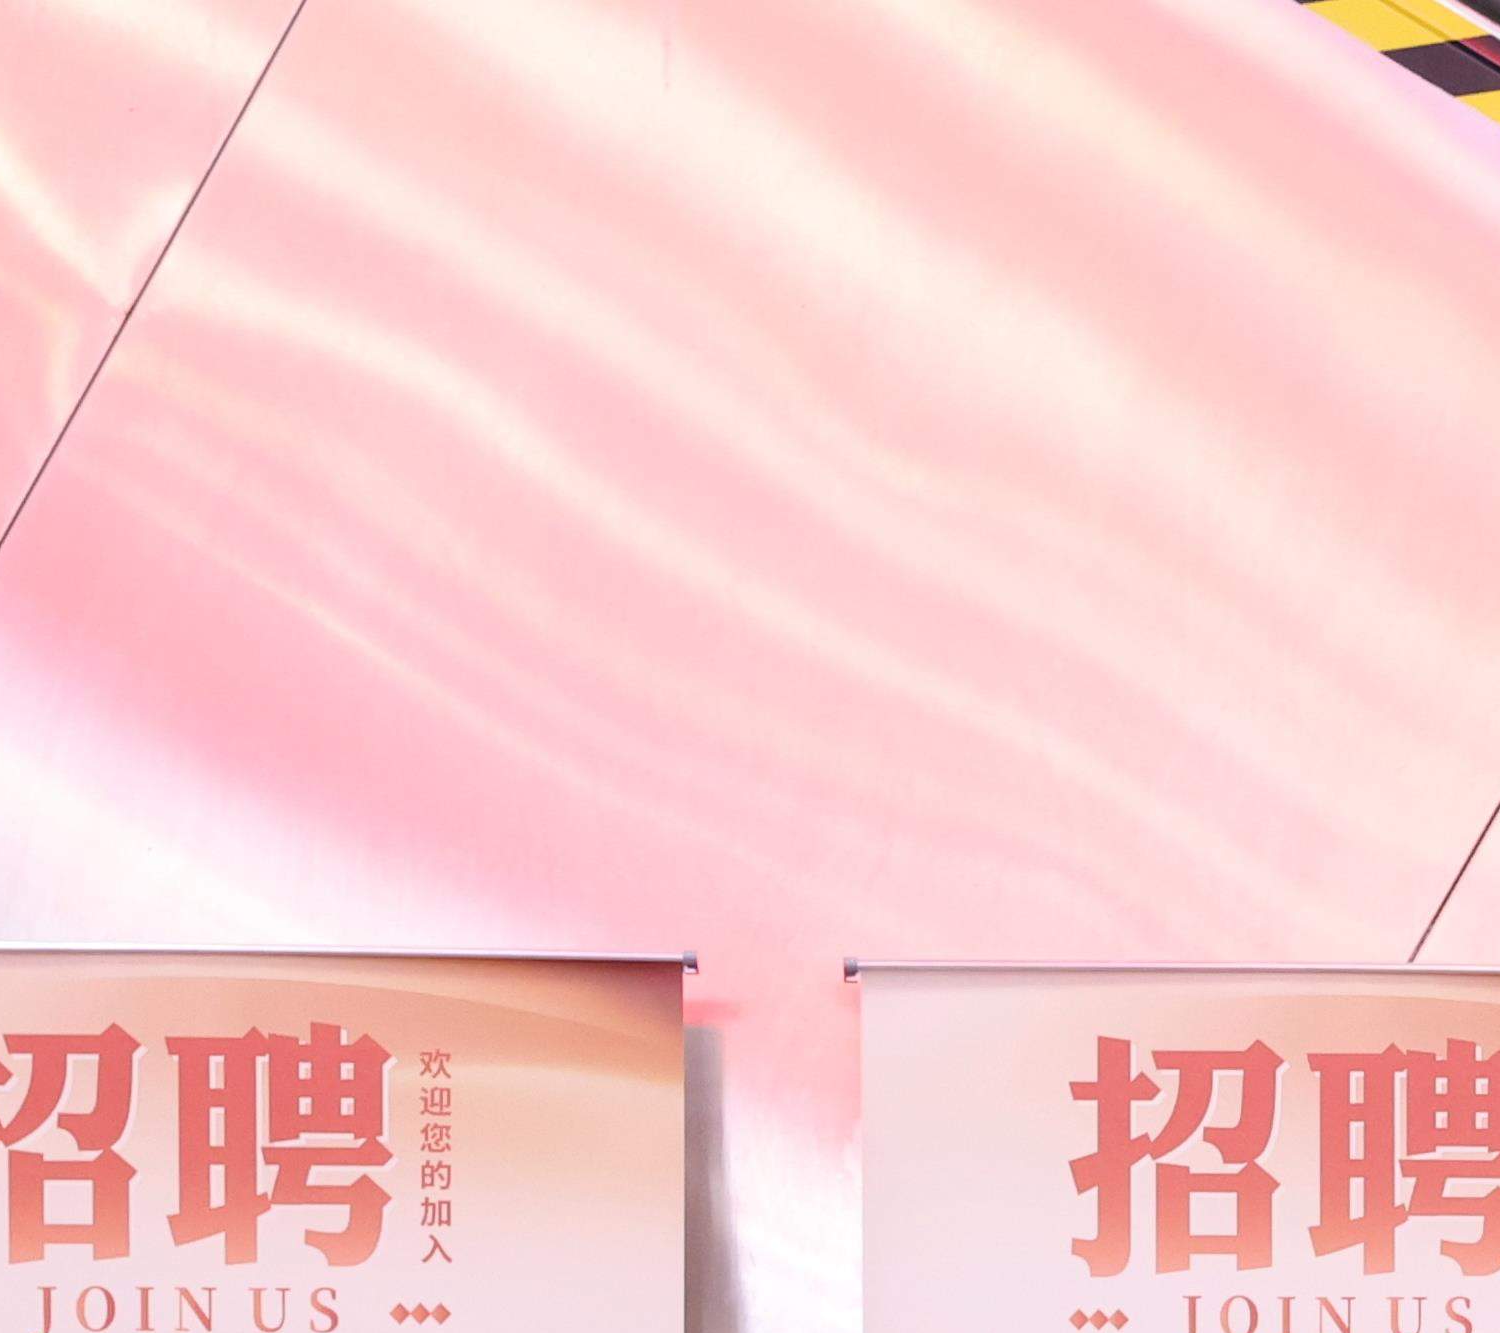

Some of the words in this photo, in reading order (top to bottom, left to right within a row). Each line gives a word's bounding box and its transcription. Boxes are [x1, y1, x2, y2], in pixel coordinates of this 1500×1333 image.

[418, 1049, 453, 1265] 欢迎您的加入
[249, 1287, 341, 1333] US
